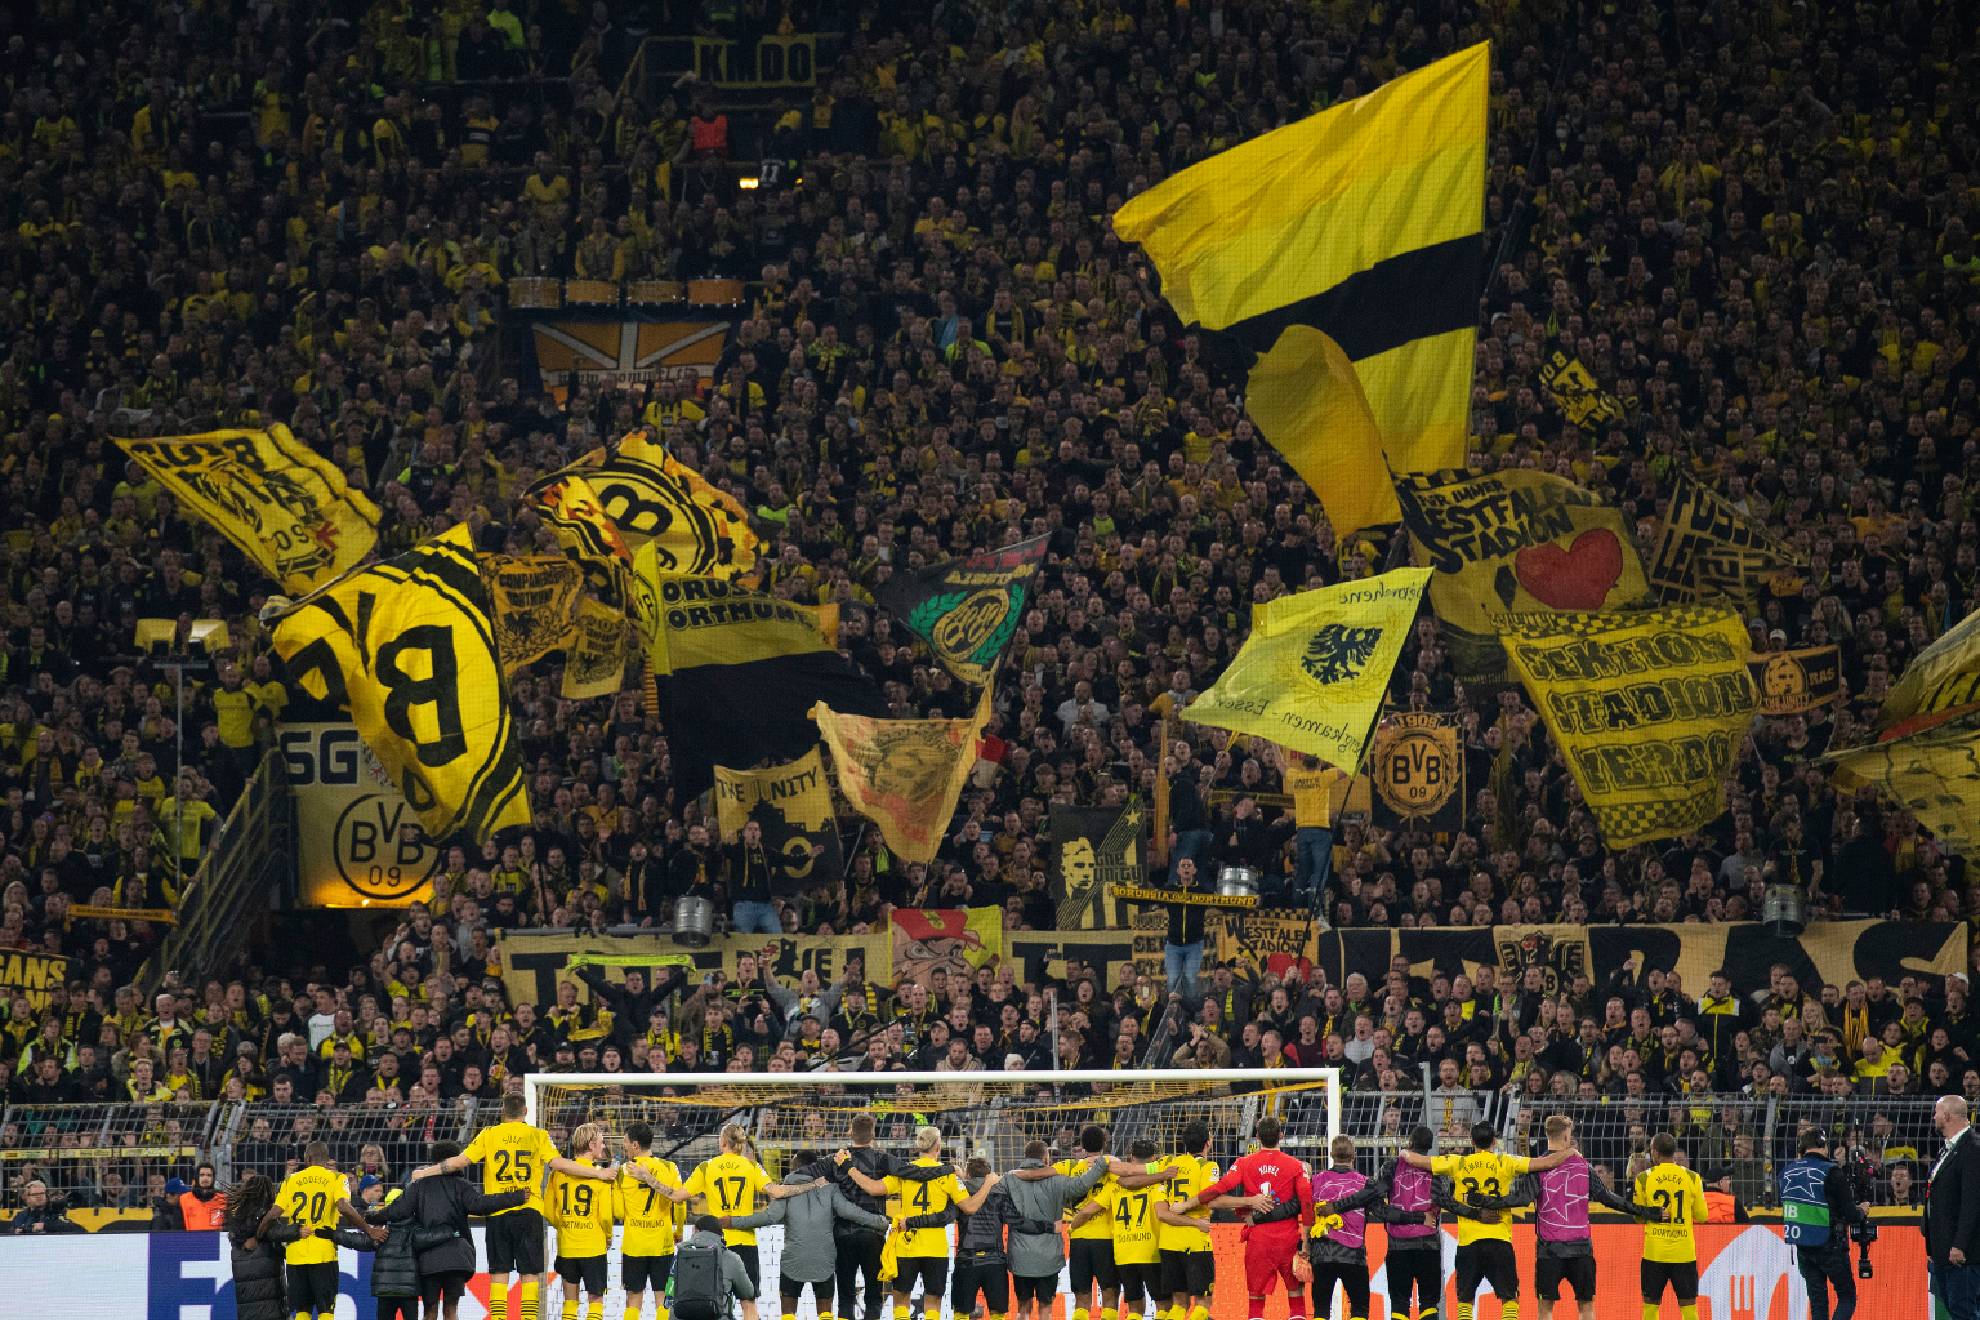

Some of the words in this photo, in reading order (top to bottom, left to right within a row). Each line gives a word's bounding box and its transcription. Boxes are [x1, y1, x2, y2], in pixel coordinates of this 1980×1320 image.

[1517, 632, 1736, 680] SEKTION
[1548, 672, 1756, 734] STADION
[1392, 743, 1441, 784] BVB
[1573, 728, 1740, 793] VERBO
[1409, 787, 1427, 798] 09
[350, 802, 425, 865] BVB
[369, 865, 401, 887] 09
[494, 1149, 532, 1182] 25
[292, 1191, 327, 1225] 20
[559, 1182, 593, 1216] 19
[637, 1184, 655, 1216] 7
[713, 1176, 746, 1211] 17
[912, 1182, 929, 1212] 4
[1653, 1190, 1684, 1224] 21
[1115, 1194, 1148, 1229] 47
